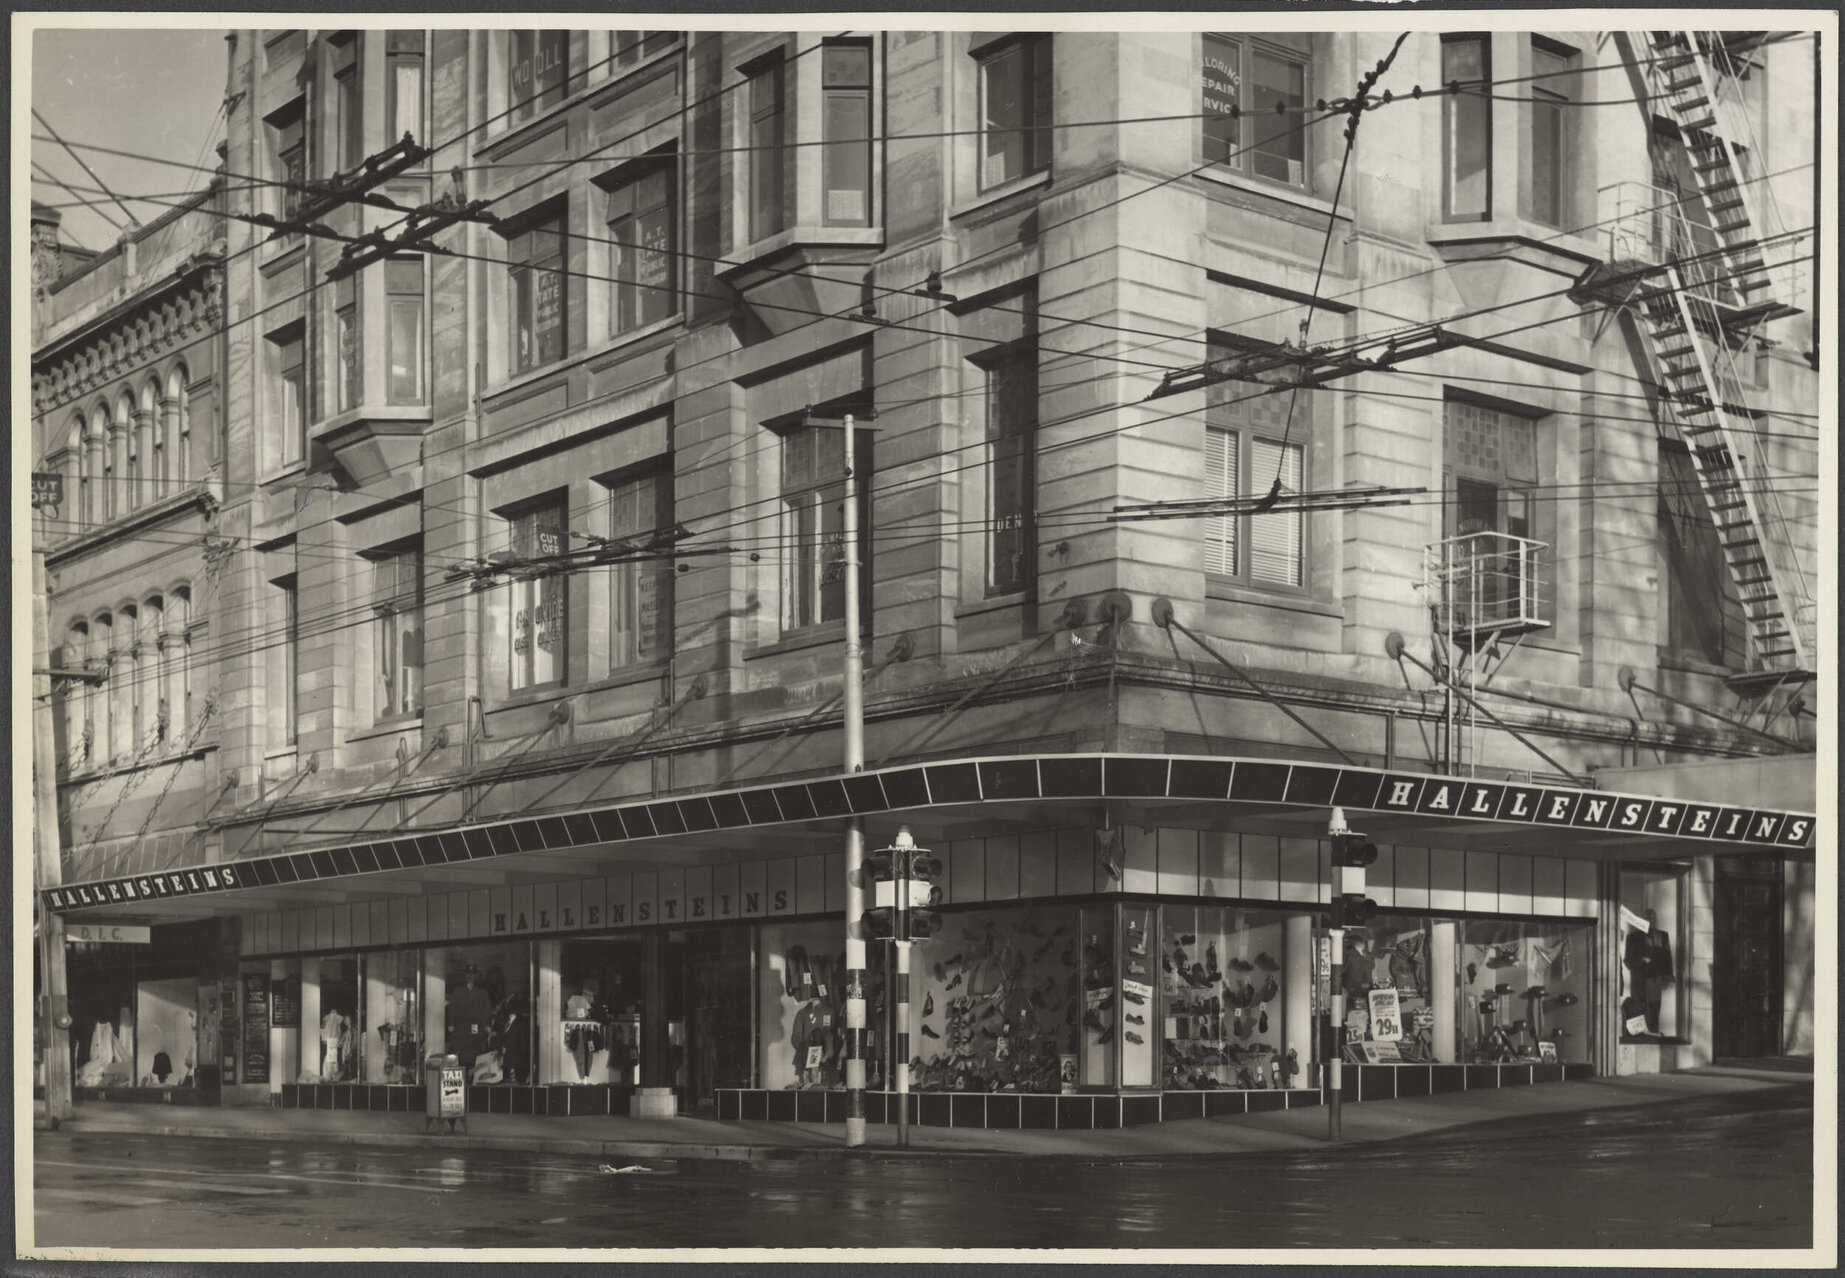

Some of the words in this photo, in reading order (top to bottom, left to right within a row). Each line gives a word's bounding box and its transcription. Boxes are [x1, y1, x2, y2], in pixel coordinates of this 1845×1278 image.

[1201, 56, 1241, 86] LORING
[1201, 76, 1235, 96] EPAIR
[1203, 96, 1232, 114] RVIC
[540, 532, 559, 544] CUT
[542, 543, 560, 556] OFF
[1387, 781, 1808, 842] HALLENSTEINS
[50, 868, 236, 908] HALLENSTEINS
[494, 890, 788, 932] HALLENSTEINS
[442, 1070, 462, 1080] TAXI
[442, 1080, 463, 1088] STAND
